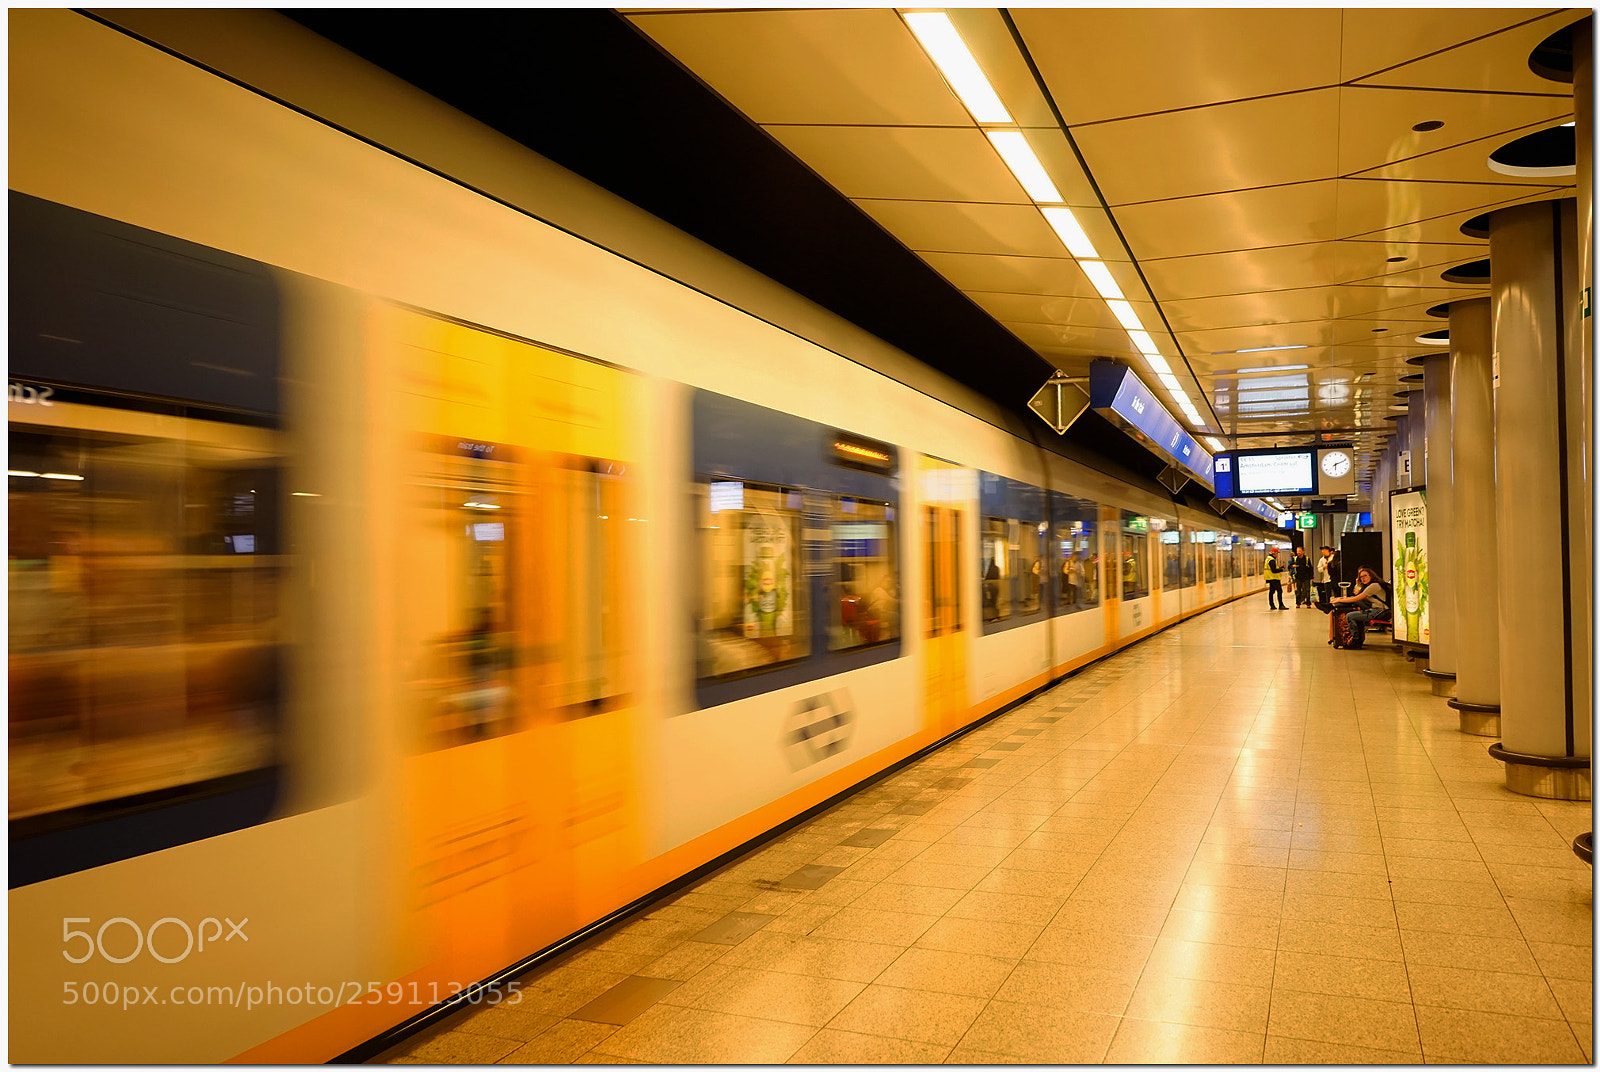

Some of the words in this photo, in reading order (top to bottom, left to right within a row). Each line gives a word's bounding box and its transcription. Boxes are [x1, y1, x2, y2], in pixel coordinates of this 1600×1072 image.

[1396, 508, 1406, 519] LOVE
[1407, 506, 1424, 518] GREEN?
[1396, 519, 1404, 529] TRY
[1405, 517, 1424, 529] MATCHA!
